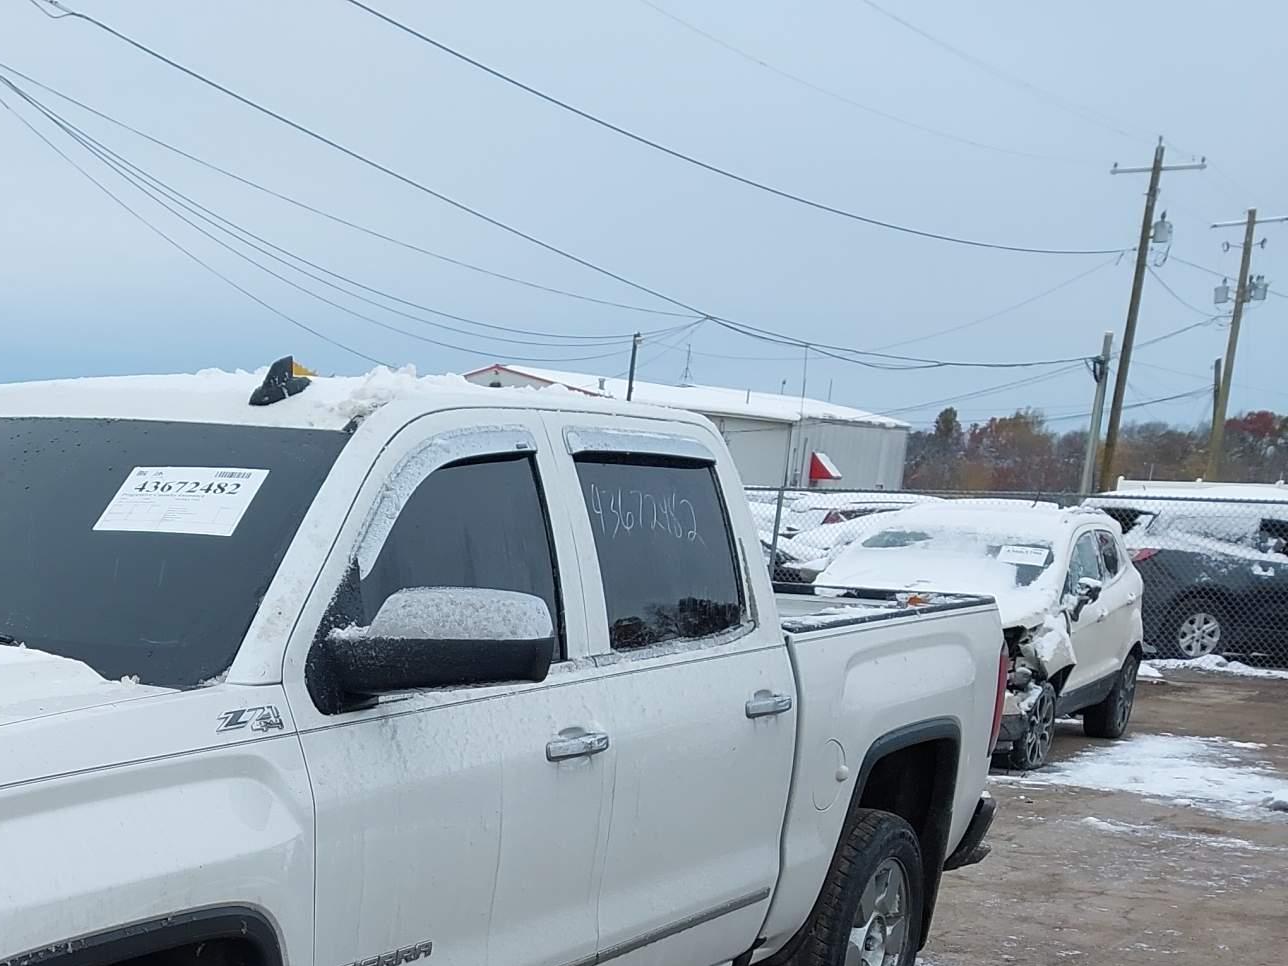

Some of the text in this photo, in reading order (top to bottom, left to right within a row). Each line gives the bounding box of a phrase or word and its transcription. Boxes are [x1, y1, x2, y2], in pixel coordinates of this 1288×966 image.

[134, 480, 242, 495] 43672482
[591, 483, 700, 542] 43672482
[215, 705, 281, 733] Z71
